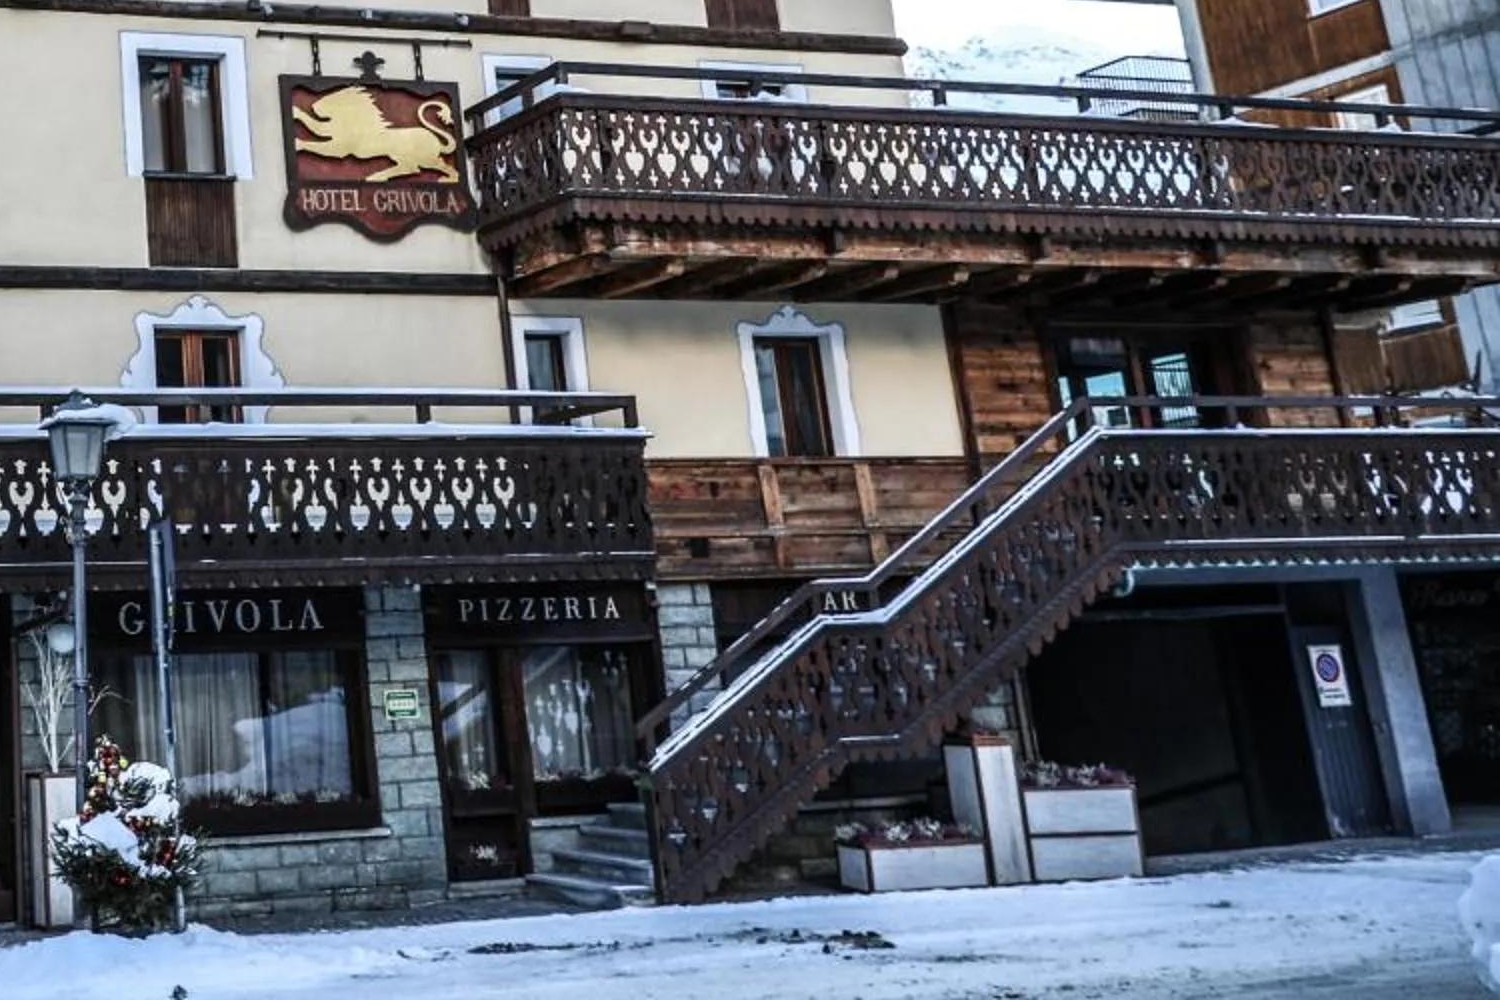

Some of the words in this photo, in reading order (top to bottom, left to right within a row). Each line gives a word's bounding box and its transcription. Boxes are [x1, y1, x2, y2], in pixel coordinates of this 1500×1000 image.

[301, 188, 366, 212] HOTEL
[373, 190, 462, 214] GRIVOLA
[458, 596, 621, 622] PIZZERIA
[823, 590, 860, 611] AR
[118, 599, 325, 635] GIVOLA
